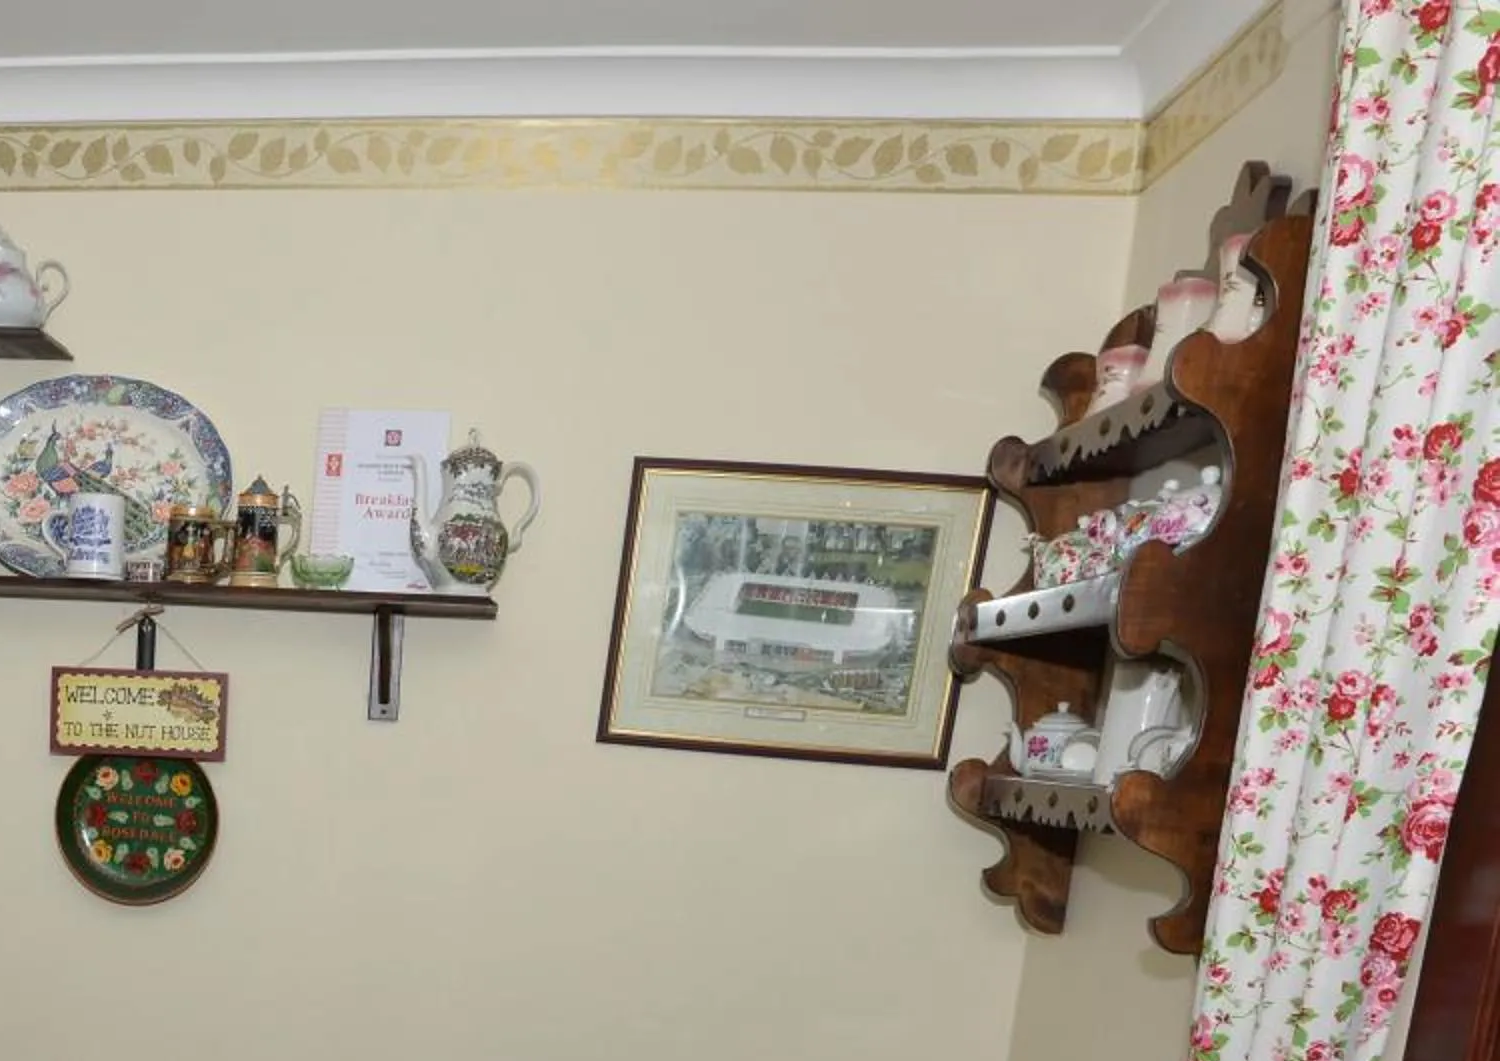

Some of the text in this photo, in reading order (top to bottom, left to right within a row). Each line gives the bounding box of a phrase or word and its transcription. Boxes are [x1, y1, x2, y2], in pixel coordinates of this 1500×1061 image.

[355, 493, 415, 506] Breakfas
[363, 508, 411, 520] Award
[65, 685, 155, 706] WELCOME
[64, 722, 211, 742] TO THE NUT HOUSE
